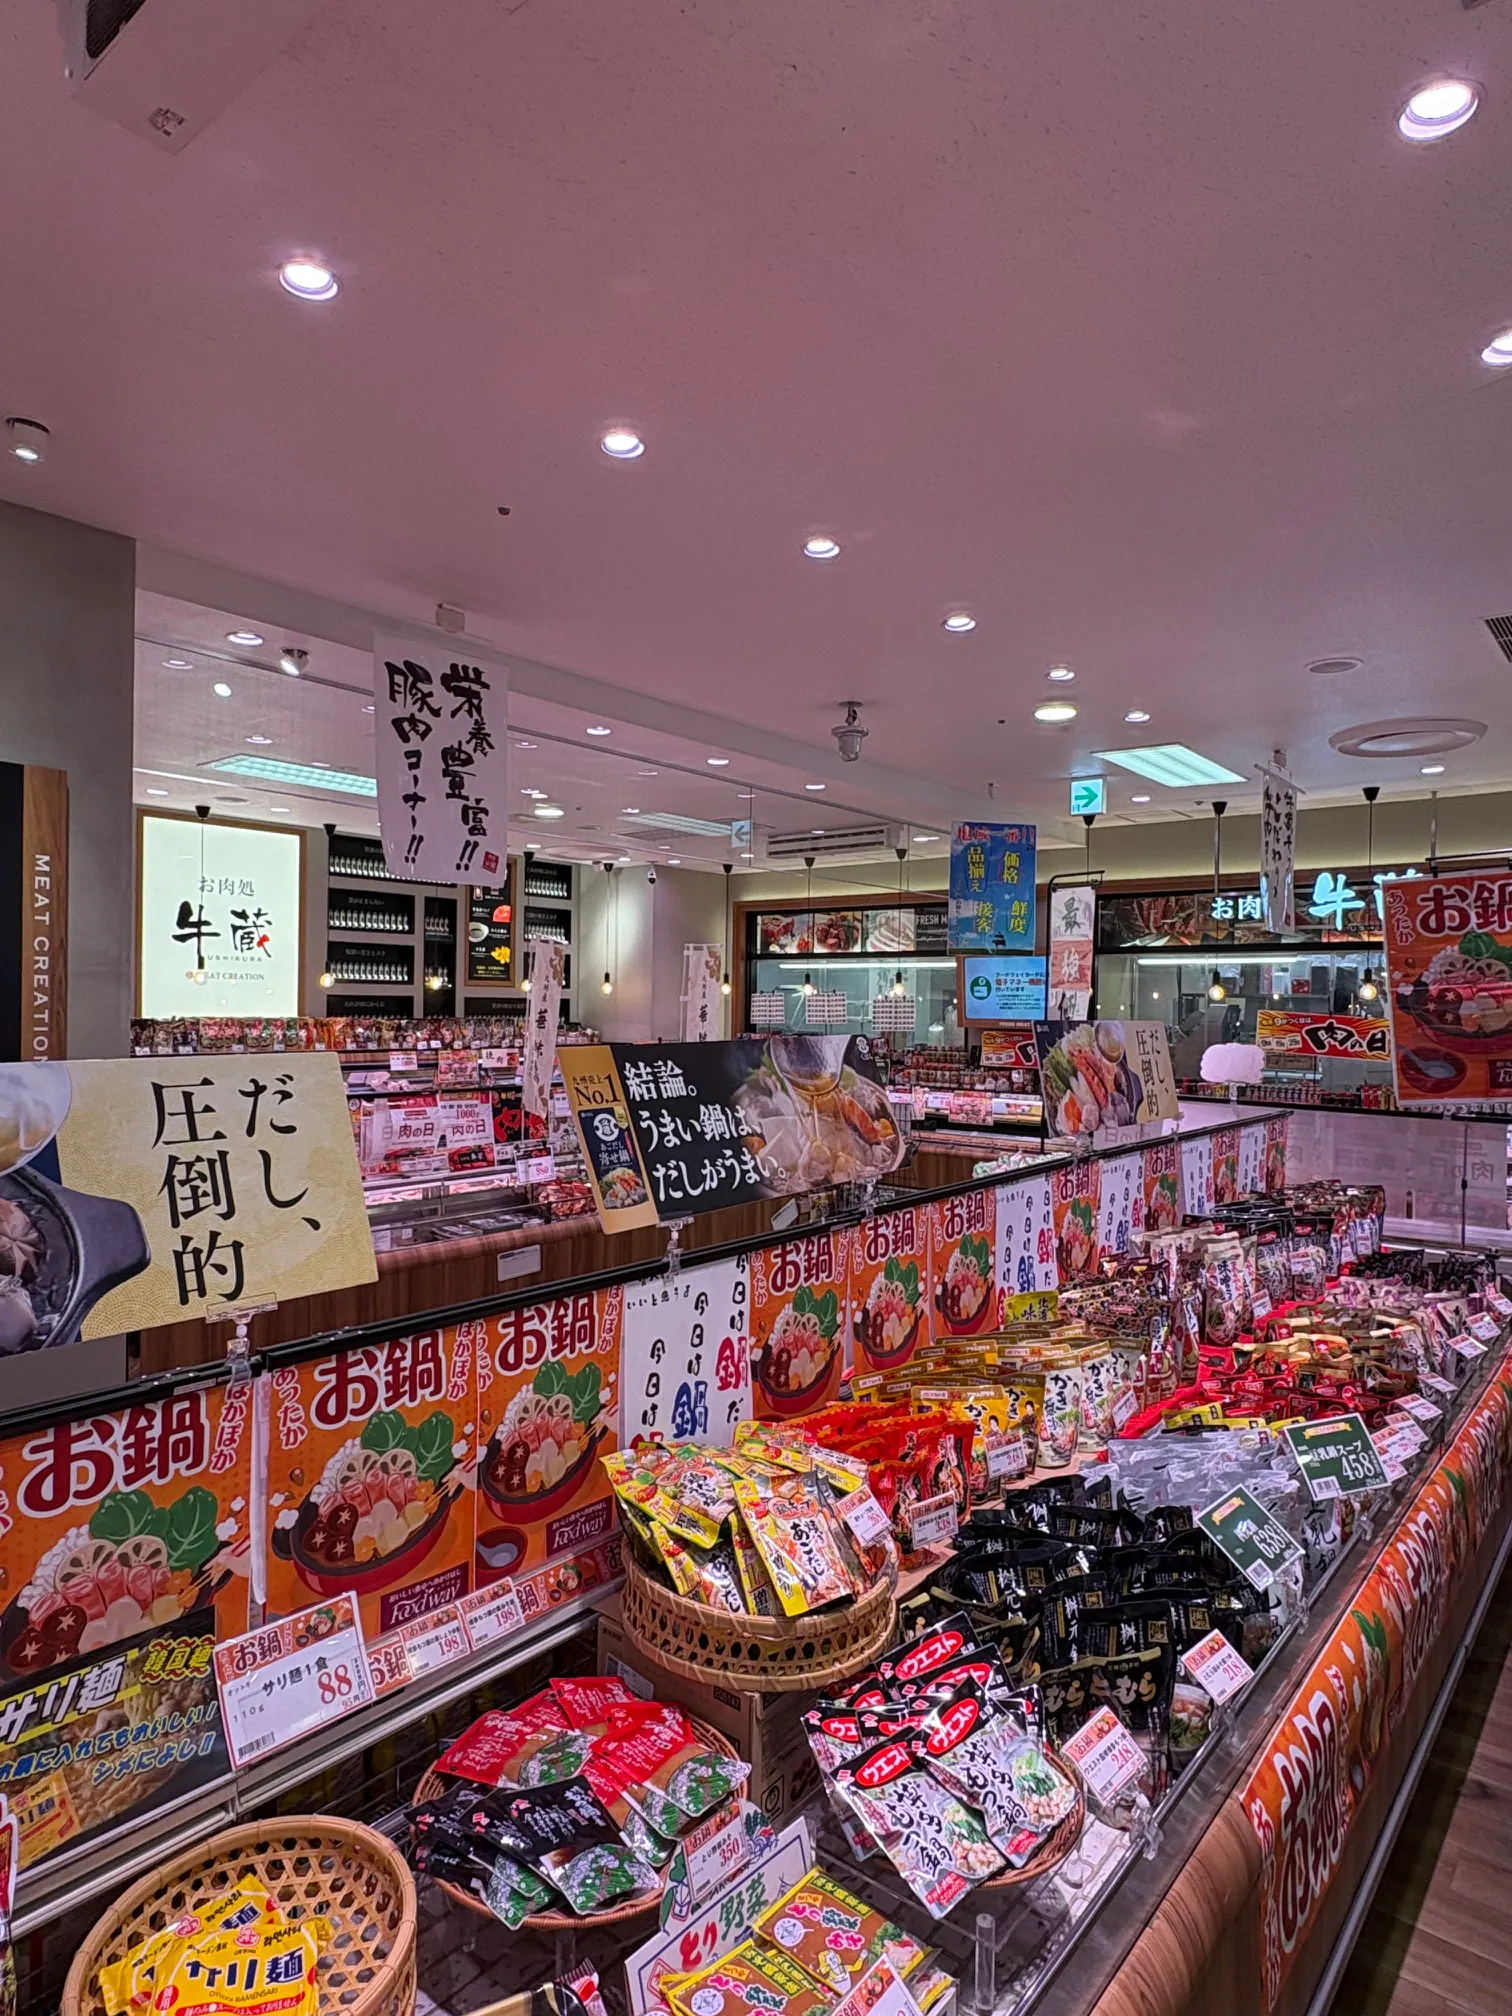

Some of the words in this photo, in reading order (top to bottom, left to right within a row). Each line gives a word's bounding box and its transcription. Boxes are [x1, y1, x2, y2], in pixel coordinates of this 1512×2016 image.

[198, 876, 256, 897] お肉処
[967, 846, 987, 893] 品揃え
[1002, 850, 1021, 885] 価格
[33, 854, 50, 925] MEAT
[171, 900, 273, 970] 牛蔵
[915, 914, 940, 926] FRESH
[975, 900, 994, 934] 接客
[1008, 899, 1029, 934] 鮮度
[1386, 888, 1416, 946] あったか
[222, 972, 265, 981] CREATION
[1302, 1019, 1389, 1053] 肉の日
[573, 1074, 622, 1107] No.1
[623, 1059, 698, 1102] 結論。
[1135, 1029, 1159, 1117] 圧倒的
[399, 1122, 435, 1140] 肉の日
[452, 1118, 486, 1137] 肉の日
[638, 1103, 763, 1153] うまい鍋は、
[237, 1073, 321, 1232] だし、
[598, 1151, 631, 1167] 寄せ鍋
[1150, 1144, 1177, 1177] お鍋
[150, 1077, 245, 1307] 圧倒的
[652, 1147, 787, 1202] だしがうまい。
[1058, 1165, 1091, 1203] お鍋
[864, 1207, 917, 1265] お鍋
[930, 1202, 943, 1252] あったか
[943, 1190, 987, 1242] お鍋
[751, 1250, 768, 1308] あったか
[769, 1232, 836, 1297] お鍋
[495, 1290, 601, 1377] お鍋
[311, 1330, 447, 1430] お鍋
[447, 1321, 474, 1401] ぽかぽか
[670, 1291, 709, 1439] 今日は鍋
[272, 1365, 308, 1450] あったか
[1004, 1387, 1027, 1420] かき
[1050, 1373, 1073, 1412] かき
[18, 1390, 209, 1518] お鍋
[1341, 1452, 1376, 1482] 458
[789, 1520, 827, 1577] あごだし
[1252, 1523, 1287, 1560] 638
[467, 1593, 486, 1610] お鍋
[494, 1606, 516, 1628] 198
[408, 1619, 430, 1639] お鍋
[438, 1635, 460, 1657] 198
[140, 1643, 213, 1675] 韓国麺
[233, 1629, 284, 1673] お鍋
[899, 1635, 961, 1678] ウエスト
[1222, 1660, 1243, 1682] 218
[261, 1655, 330, 1697] サリ麺1食
[316, 1663, 354, 1705] 88
[0, 1653, 128, 1745] サリ麺
[931, 1702, 977, 1750] ウエスト
[1077, 1736, 1094, 1756] お鍋
[1110, 1743, 1134, 1771] 248
[690, 1828, 713, 1850] お鍋
[1274, 1690, 1341, 1953] お鍋
[718, 1840, 741, 1868] 350
[826, 1931, 865, 1950] みそ
[185, 1946, 305, 1992] サリ麺
[234, 1986, 279, 2004] RAMENSARI
